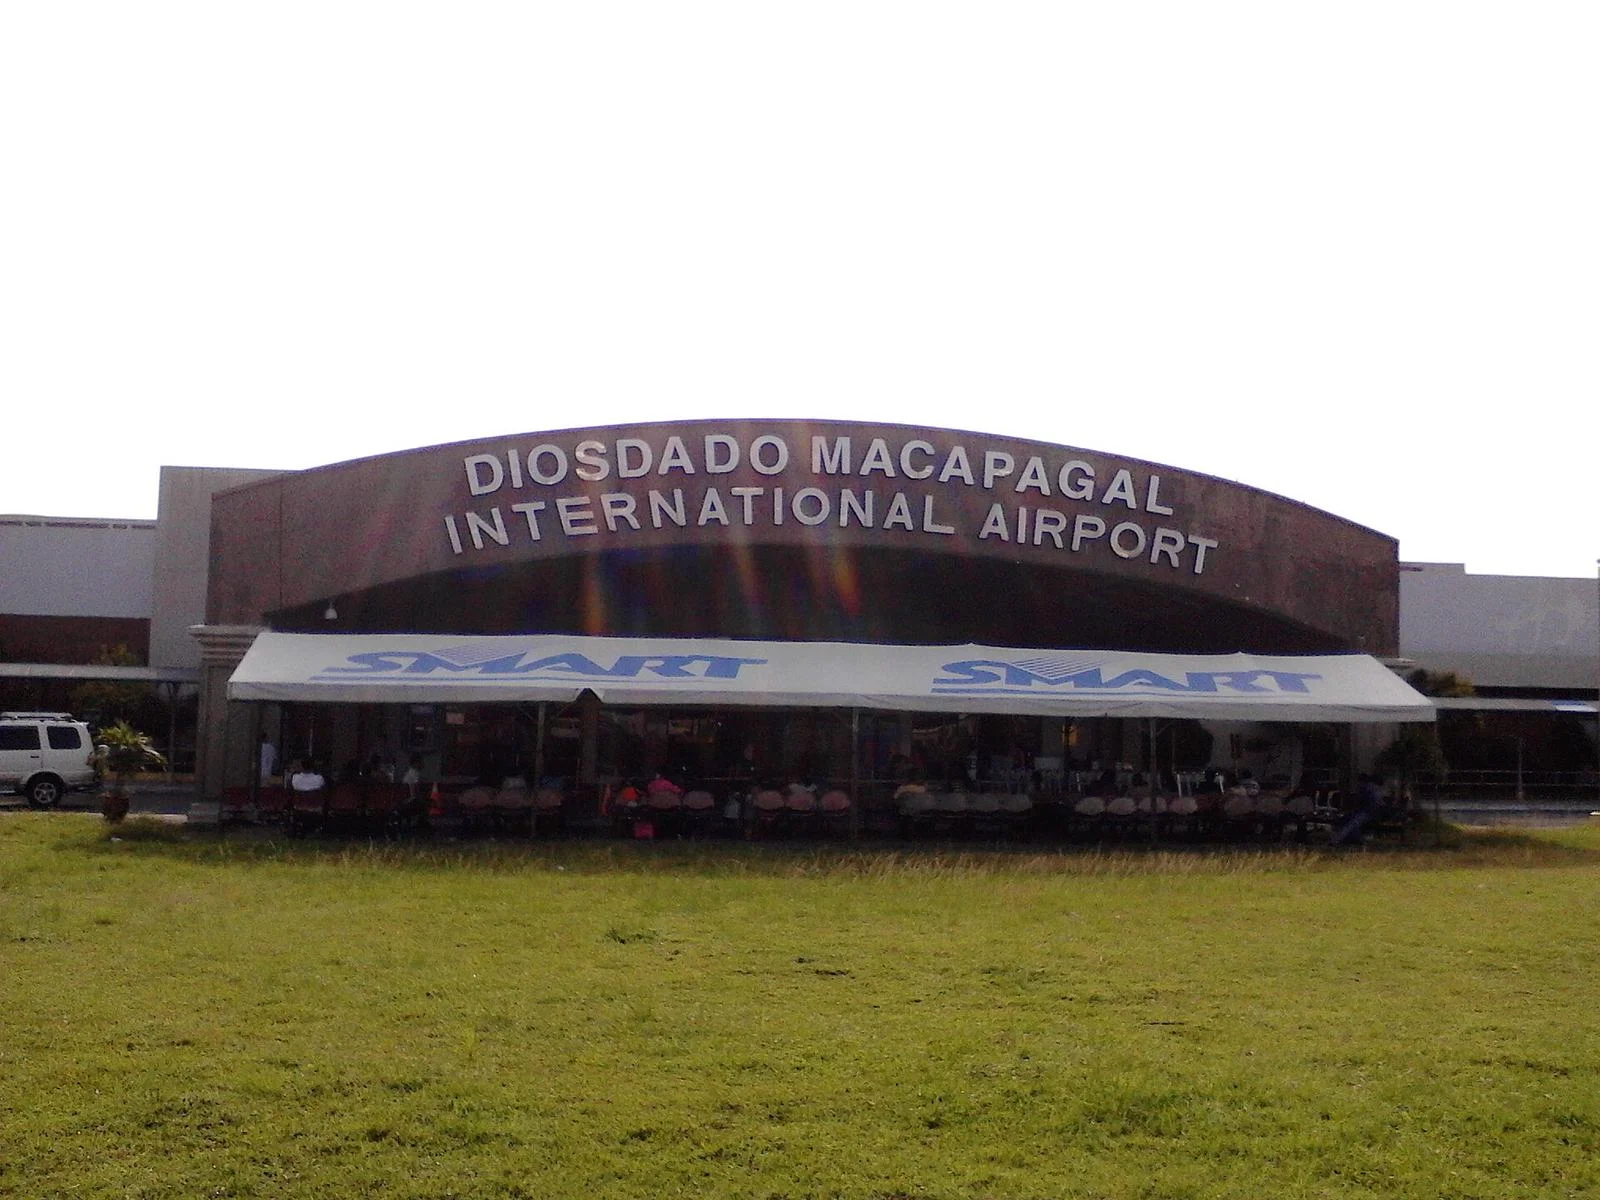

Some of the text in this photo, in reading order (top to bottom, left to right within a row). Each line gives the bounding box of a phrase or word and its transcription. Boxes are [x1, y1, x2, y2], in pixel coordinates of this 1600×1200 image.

[464, 435, 1173, 515] DIOSDADO MACAPAGAL
[445, 487, 1218, 574] INTERNATIONAL AIRPORT
[321, 650, 768, 679] SMART
[932, 659, 1323, 693] SMART
